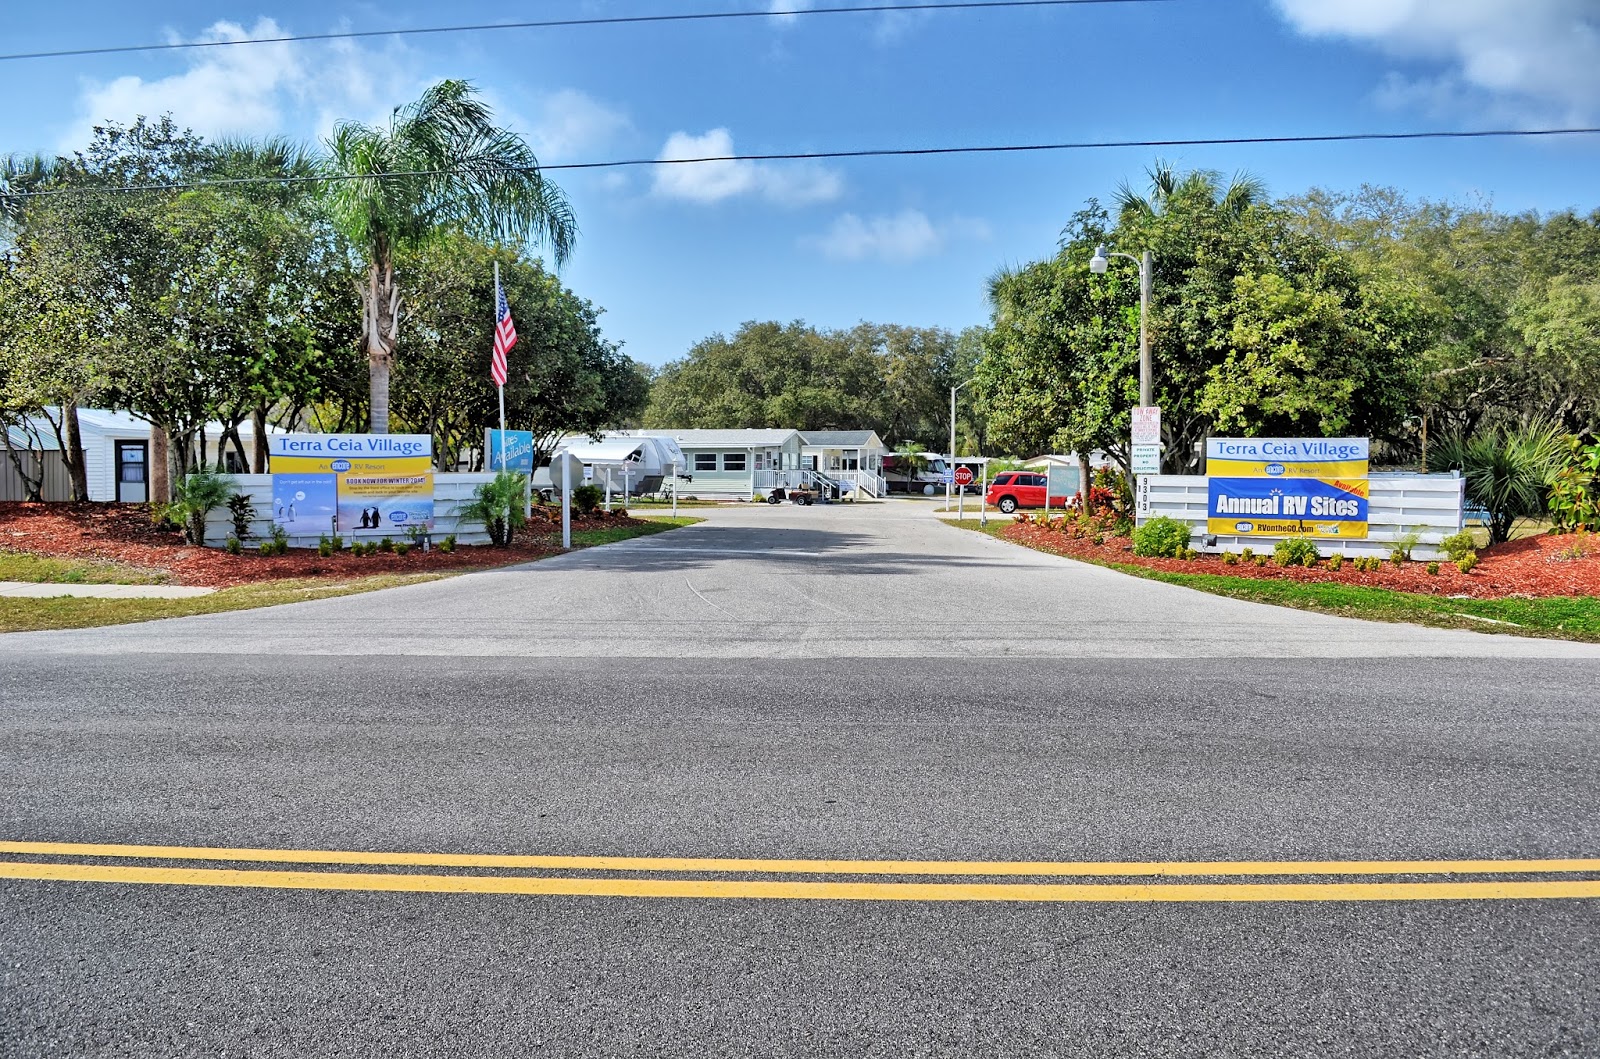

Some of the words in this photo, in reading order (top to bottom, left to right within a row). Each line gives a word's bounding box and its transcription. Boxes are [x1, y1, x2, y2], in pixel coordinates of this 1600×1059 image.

[279, 438, 322, 451] Terra
[327, 438, 362, 451] Ceia
[368, 438, 422, 455] Village
[1217, 442, 1257, 455] Terra
[1262, 442, 1296, 455] Ceia
[1302, 442, 1359, 458] Village
[1334, 480, 1364, 497] Available
[1216, 495, 1279, 515] Annual
[1283, 496, 1307, 515] RV
[1310, 496, 1358, 516] Sites
[1257, 524, 1314, 533] RVontheGO.com
